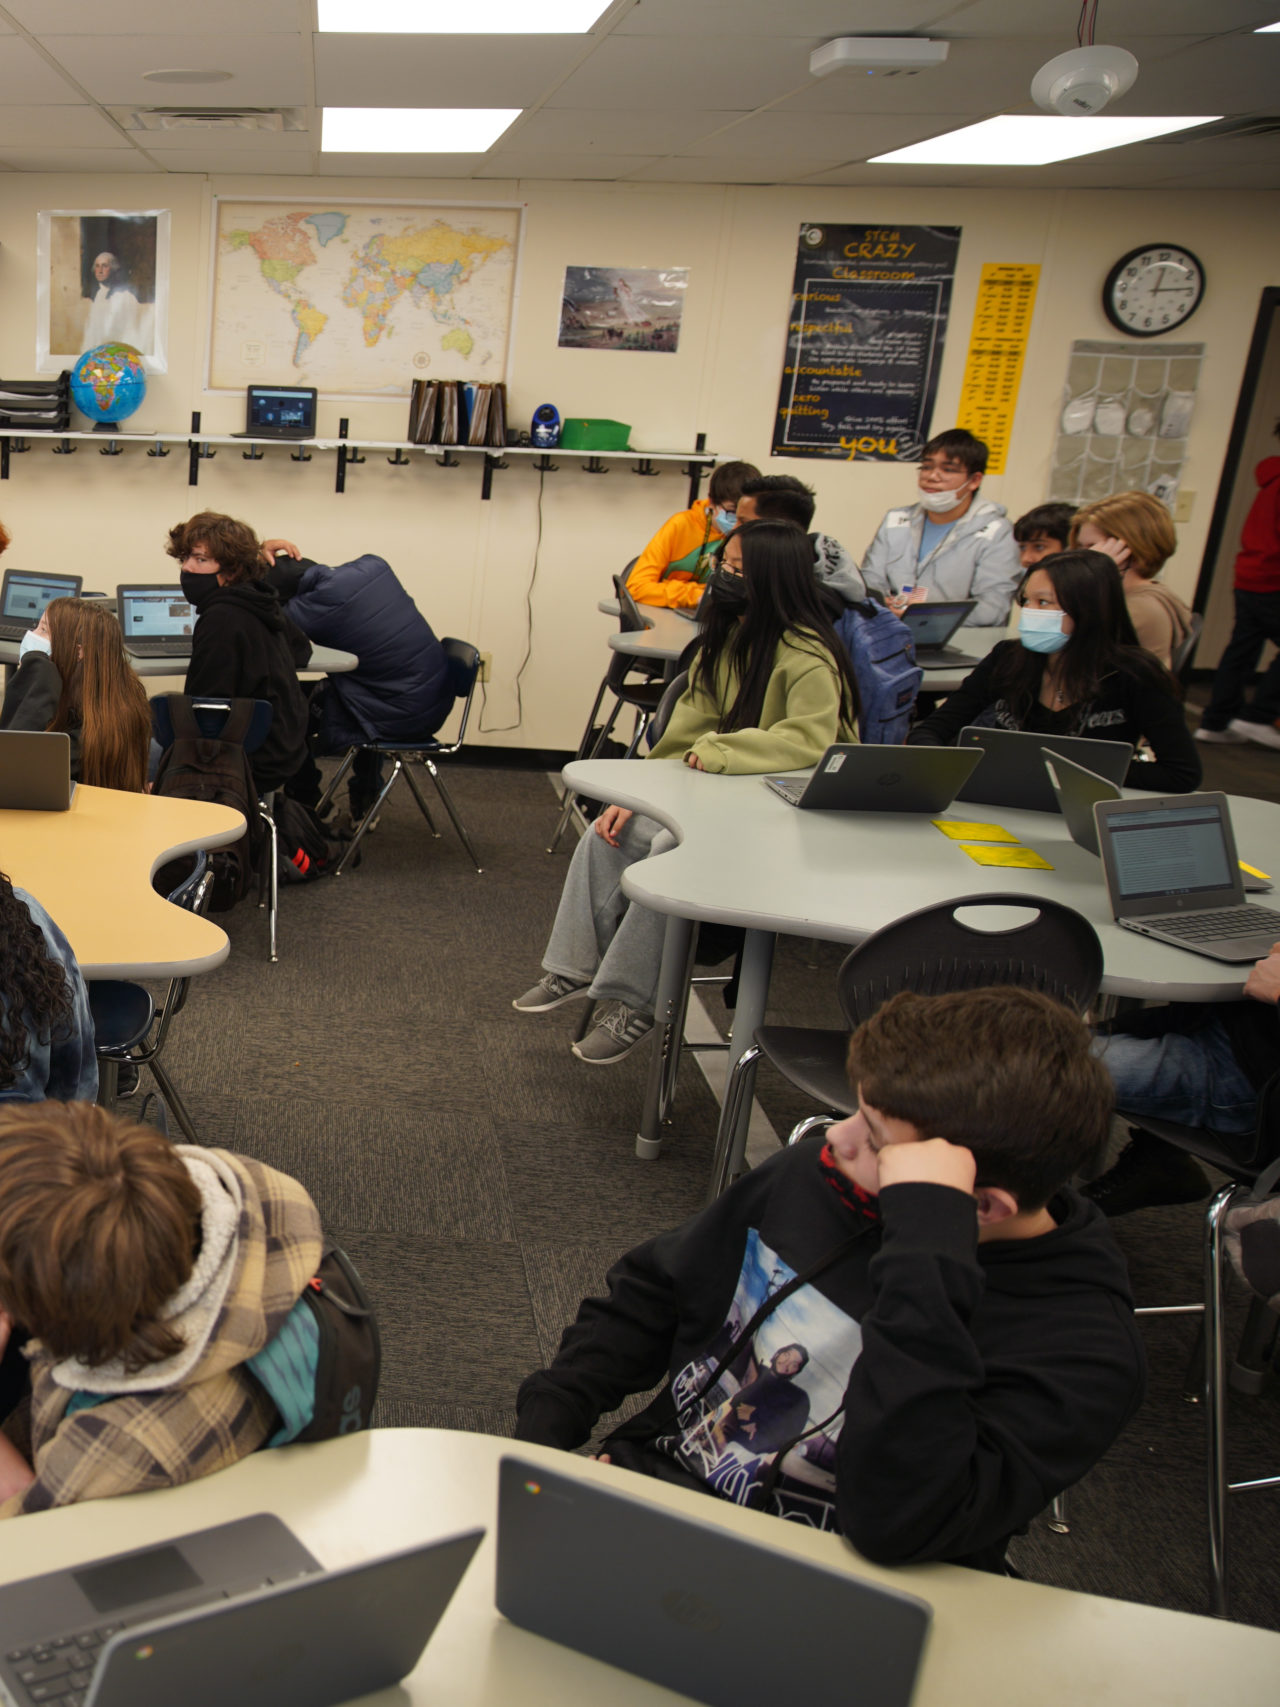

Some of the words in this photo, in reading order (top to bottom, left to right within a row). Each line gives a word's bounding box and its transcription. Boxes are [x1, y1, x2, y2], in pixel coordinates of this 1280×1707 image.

[864, 229, 900, 243] STEM
[843, 241, 917, 259] CRAZY
[1141, 256, 1152, 266] 11
[1159, 252, 1171, 261] 12
[832, 266, 916, 281] Classroom
[1127, 267, 1138, 277] 10
[1186, 269, 1194, 281] 2
[1120, 282, 1128, 293] 9
[793, 291, 841, 303] curious
[1120, 300, 1128, 310] 8
[1177, 304, 1186, 313] 4
[1129, 312, 1136, 322] 7
[1144, 317, 1152, 328] 6
[1162, 314, 1170, 325] 5
[789, 319, 853, 338] respectful
[783, 363, 863, 377] accountable
[792, 393, 821, 403] zero
[779, 404, 829, 421] quitting
[839, 435, 899, 461] you
